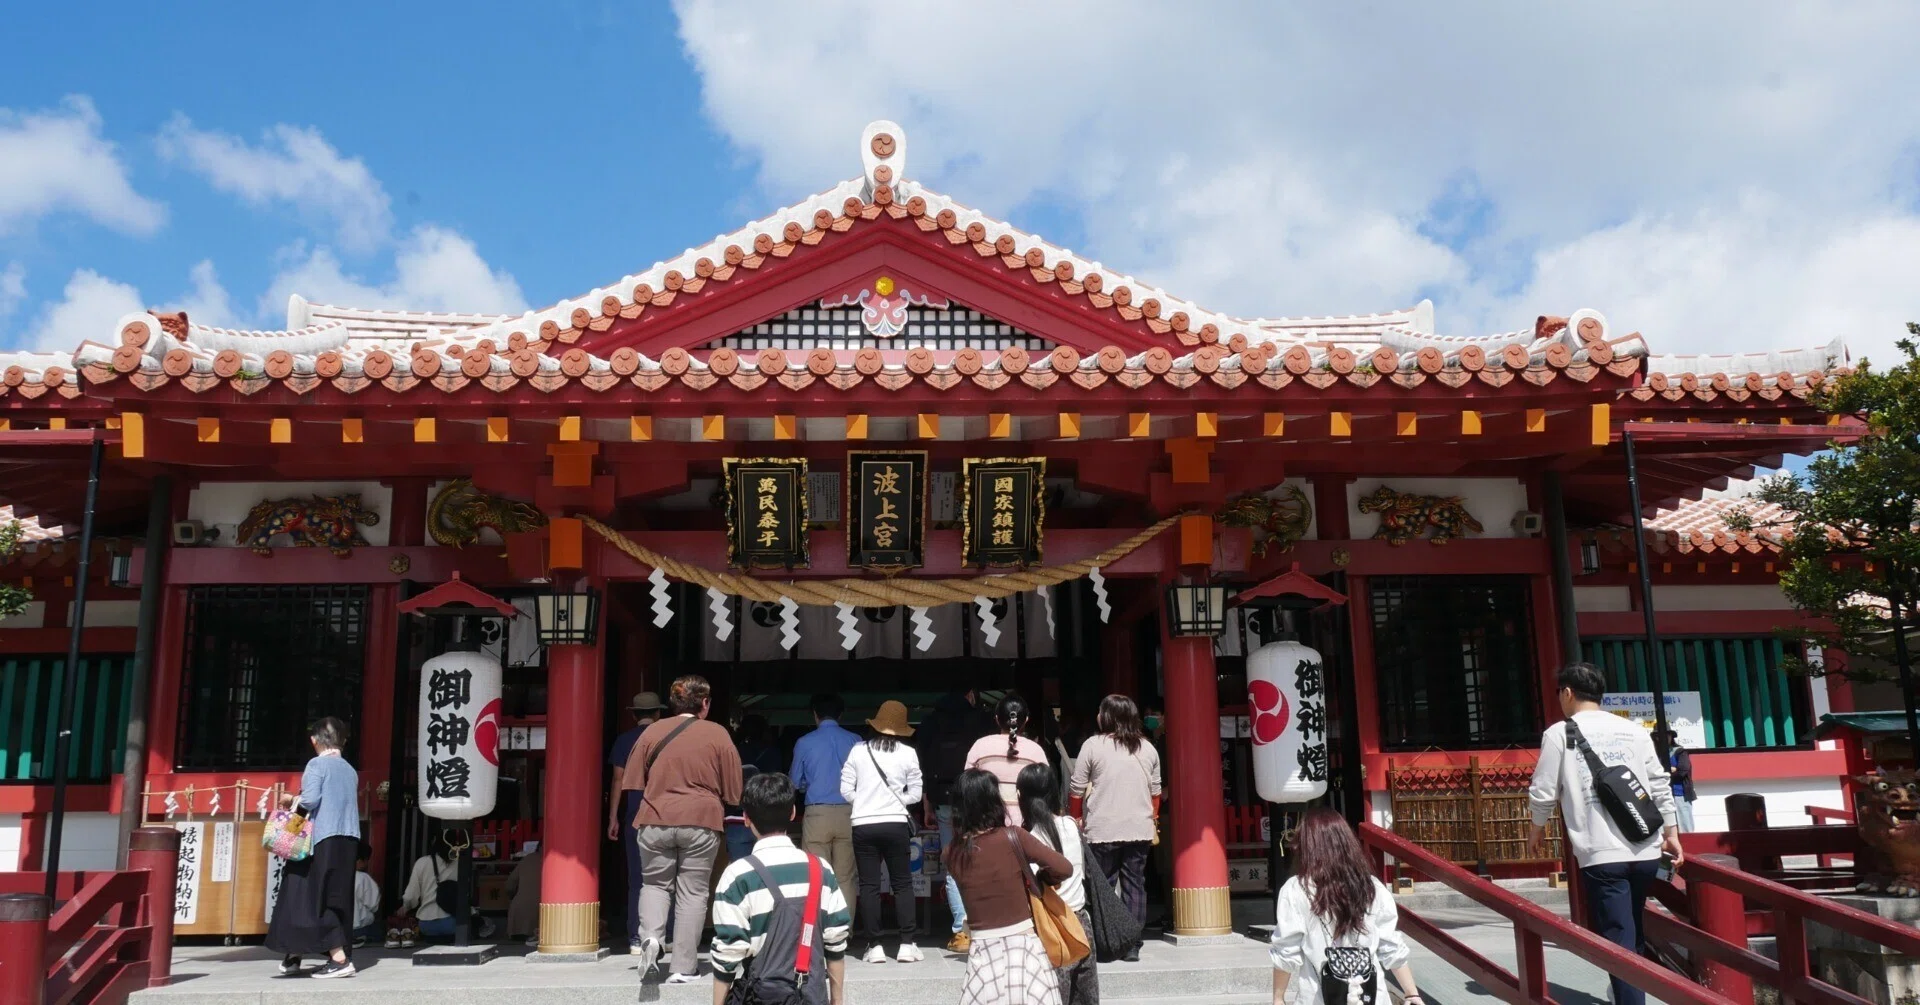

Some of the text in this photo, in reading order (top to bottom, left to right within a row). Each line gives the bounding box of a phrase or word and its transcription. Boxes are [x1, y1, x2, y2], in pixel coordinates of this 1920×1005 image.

[756, 477, 781, 547] 萬民泰平
[873, 465, 902, 548] 波上宮
[426, 668, 473, 799] 御神燈
[1294, 659, 1328, 783] 御神燈
